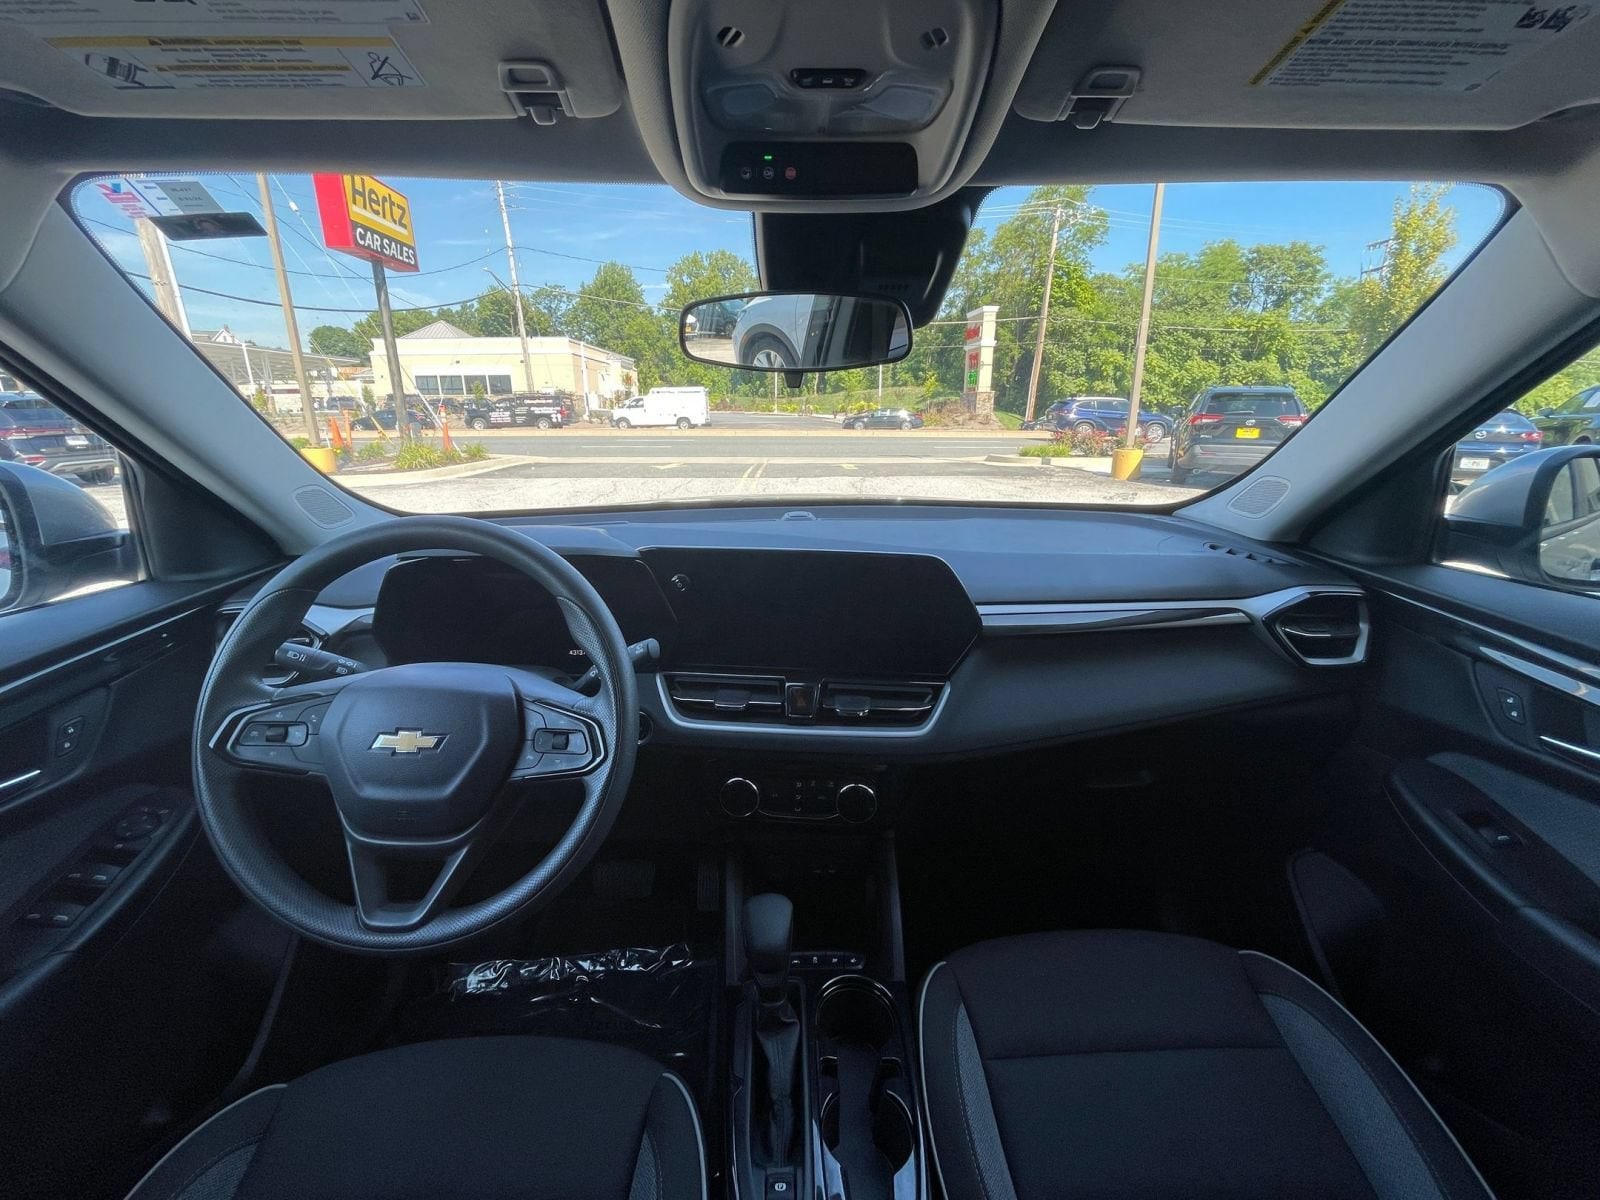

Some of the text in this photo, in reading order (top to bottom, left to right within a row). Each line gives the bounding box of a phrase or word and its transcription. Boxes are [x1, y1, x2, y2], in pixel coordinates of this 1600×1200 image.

[351, 175, 407, 230] Hertz
[356, 228, 415, 264] CAR SALES
